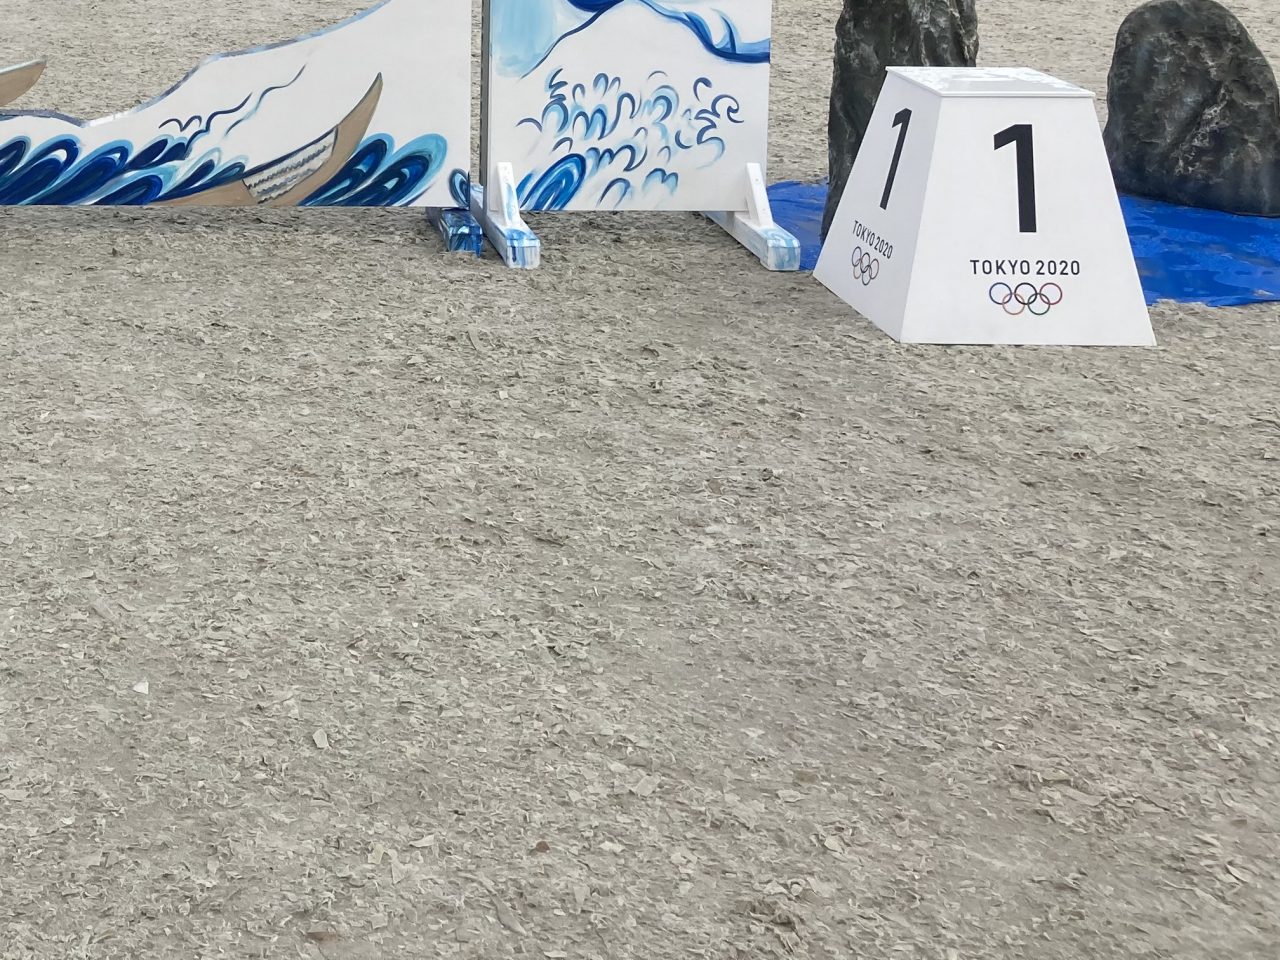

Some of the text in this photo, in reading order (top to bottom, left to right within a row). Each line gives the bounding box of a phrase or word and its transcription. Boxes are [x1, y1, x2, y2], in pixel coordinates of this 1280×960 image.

[879, 107, 913, 211] 1
[993, 123, 1038, 233] 1
[852, 219, 893, 259] TOKYO 2020
[969, 259, 1080, 276] TOKYO 2020
